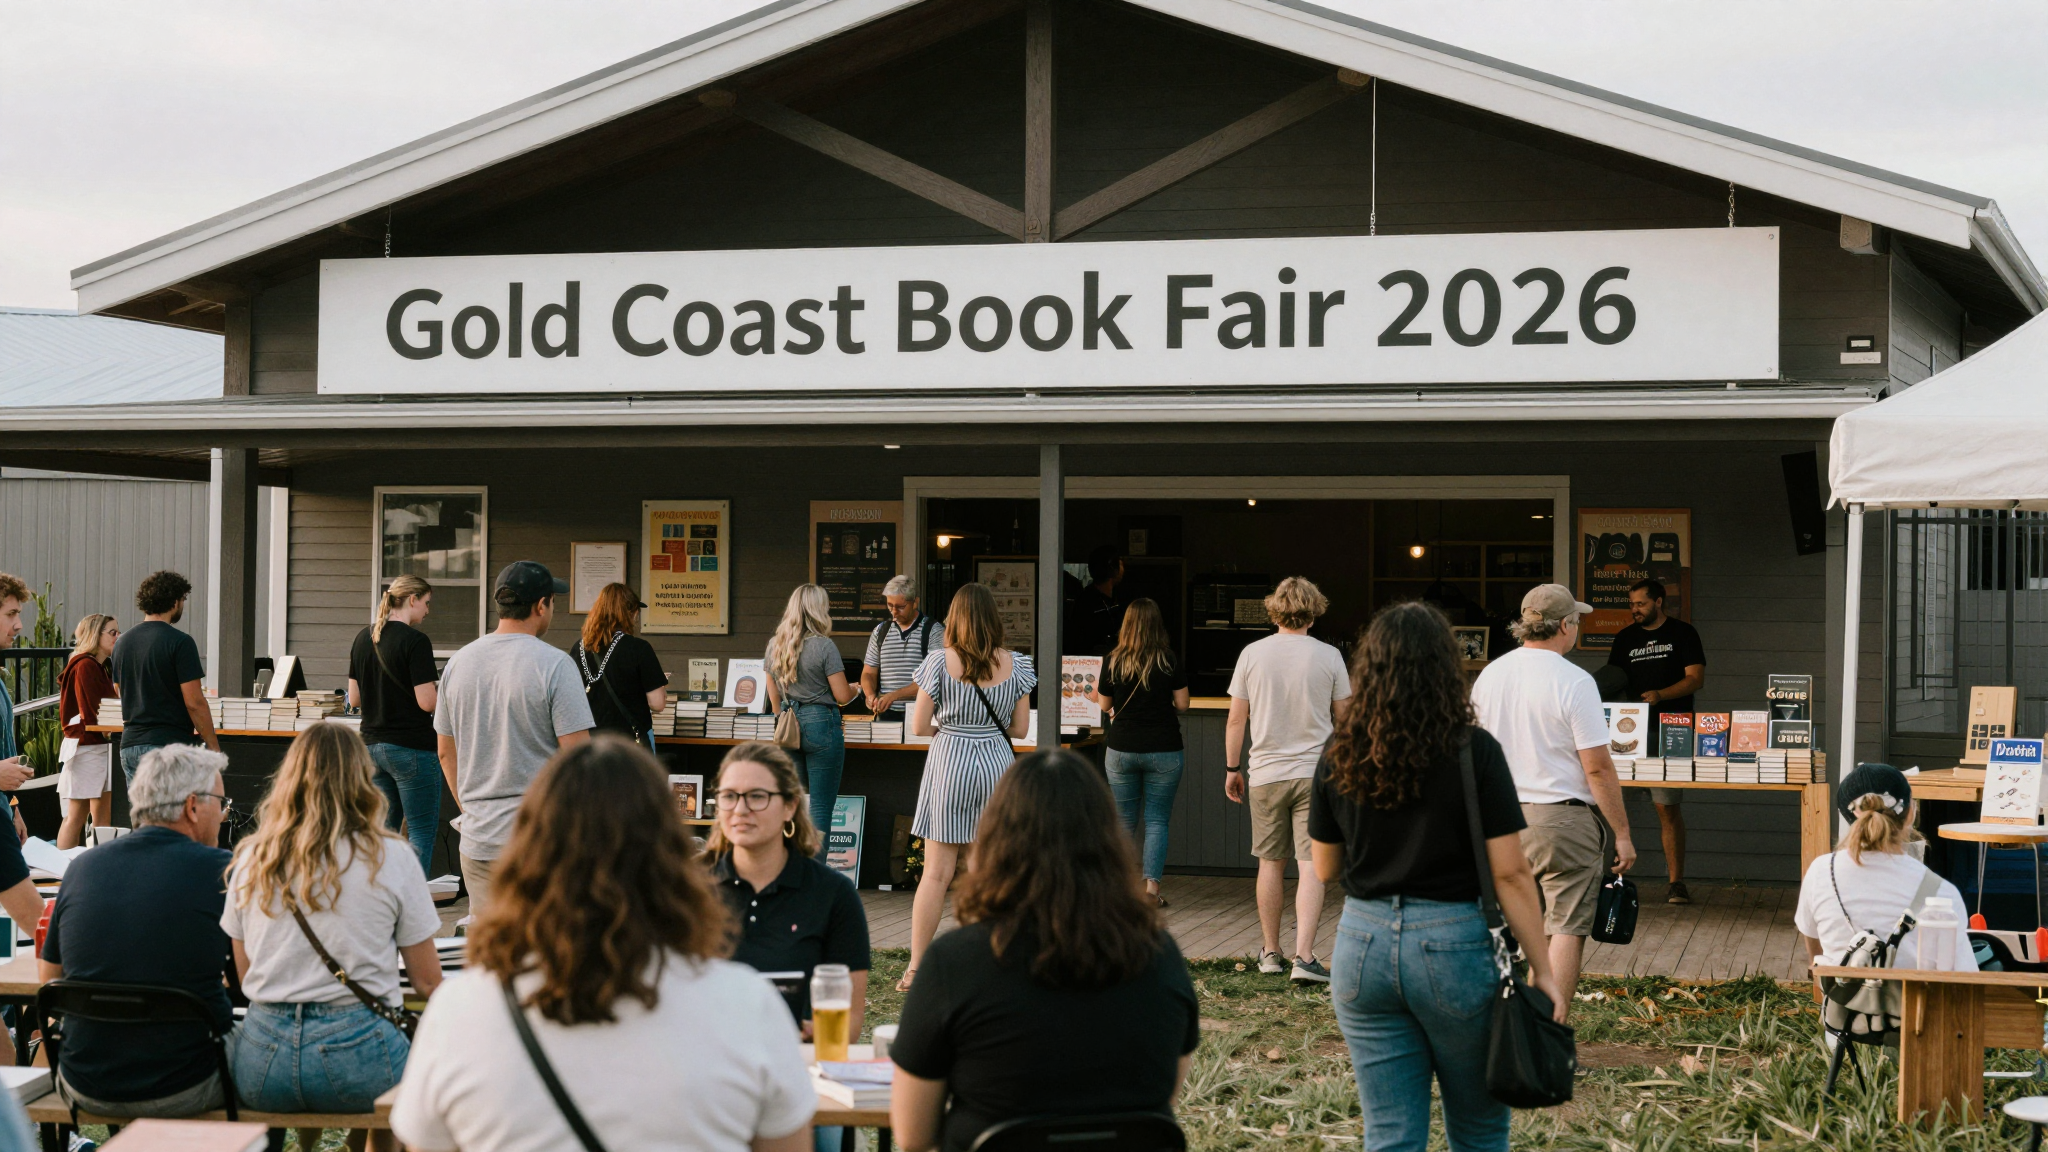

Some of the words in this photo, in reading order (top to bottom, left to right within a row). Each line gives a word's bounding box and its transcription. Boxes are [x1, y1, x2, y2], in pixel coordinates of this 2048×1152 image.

[386, 280, 581, 361] Gold
[611, 283, 866, 358] Coast
[897, 270, 1134, 353] Book
[1166, 266, 1346, 350] Fair
[1377, 266, 1637, 347] 2026
